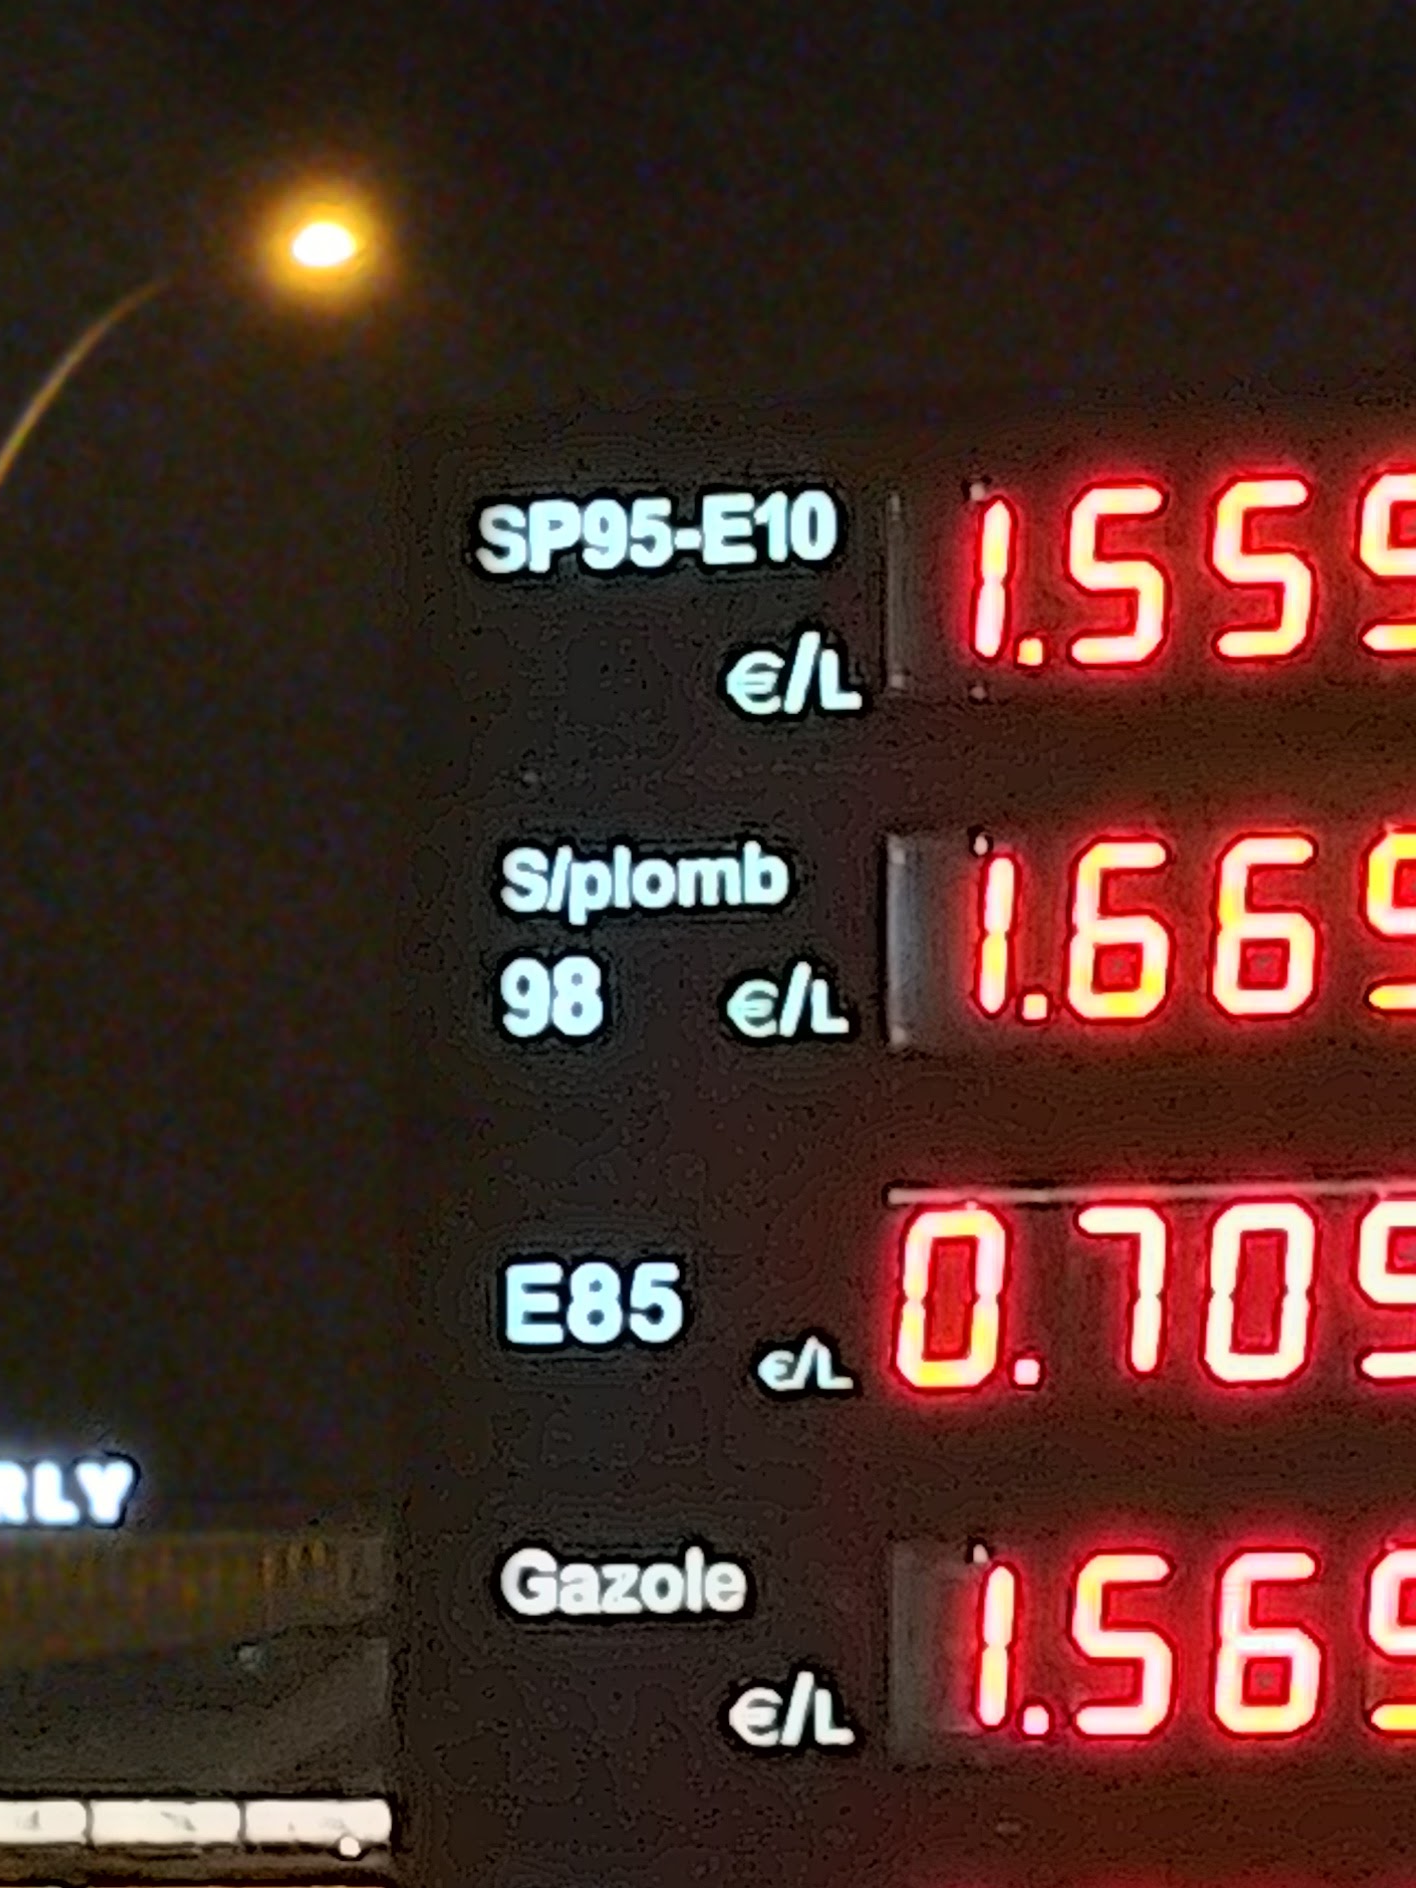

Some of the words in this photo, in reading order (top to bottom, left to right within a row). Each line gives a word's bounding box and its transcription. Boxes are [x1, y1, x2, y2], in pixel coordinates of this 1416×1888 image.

[477, 491, 837, 573] SP95-E10
[727, 632, 862, 714] €/L
[501, 841, 789, 923] S/plomb
[501, 957, 603, 1037] 98
[727, 962, 849, 1037] €/L
[506, 1262, 682, 1344] E85
[758, 1337, 852, 1390] €/L
[501, 1547, 746, 1615] Gazole
[729, 1672, 854, 1746] €/L
